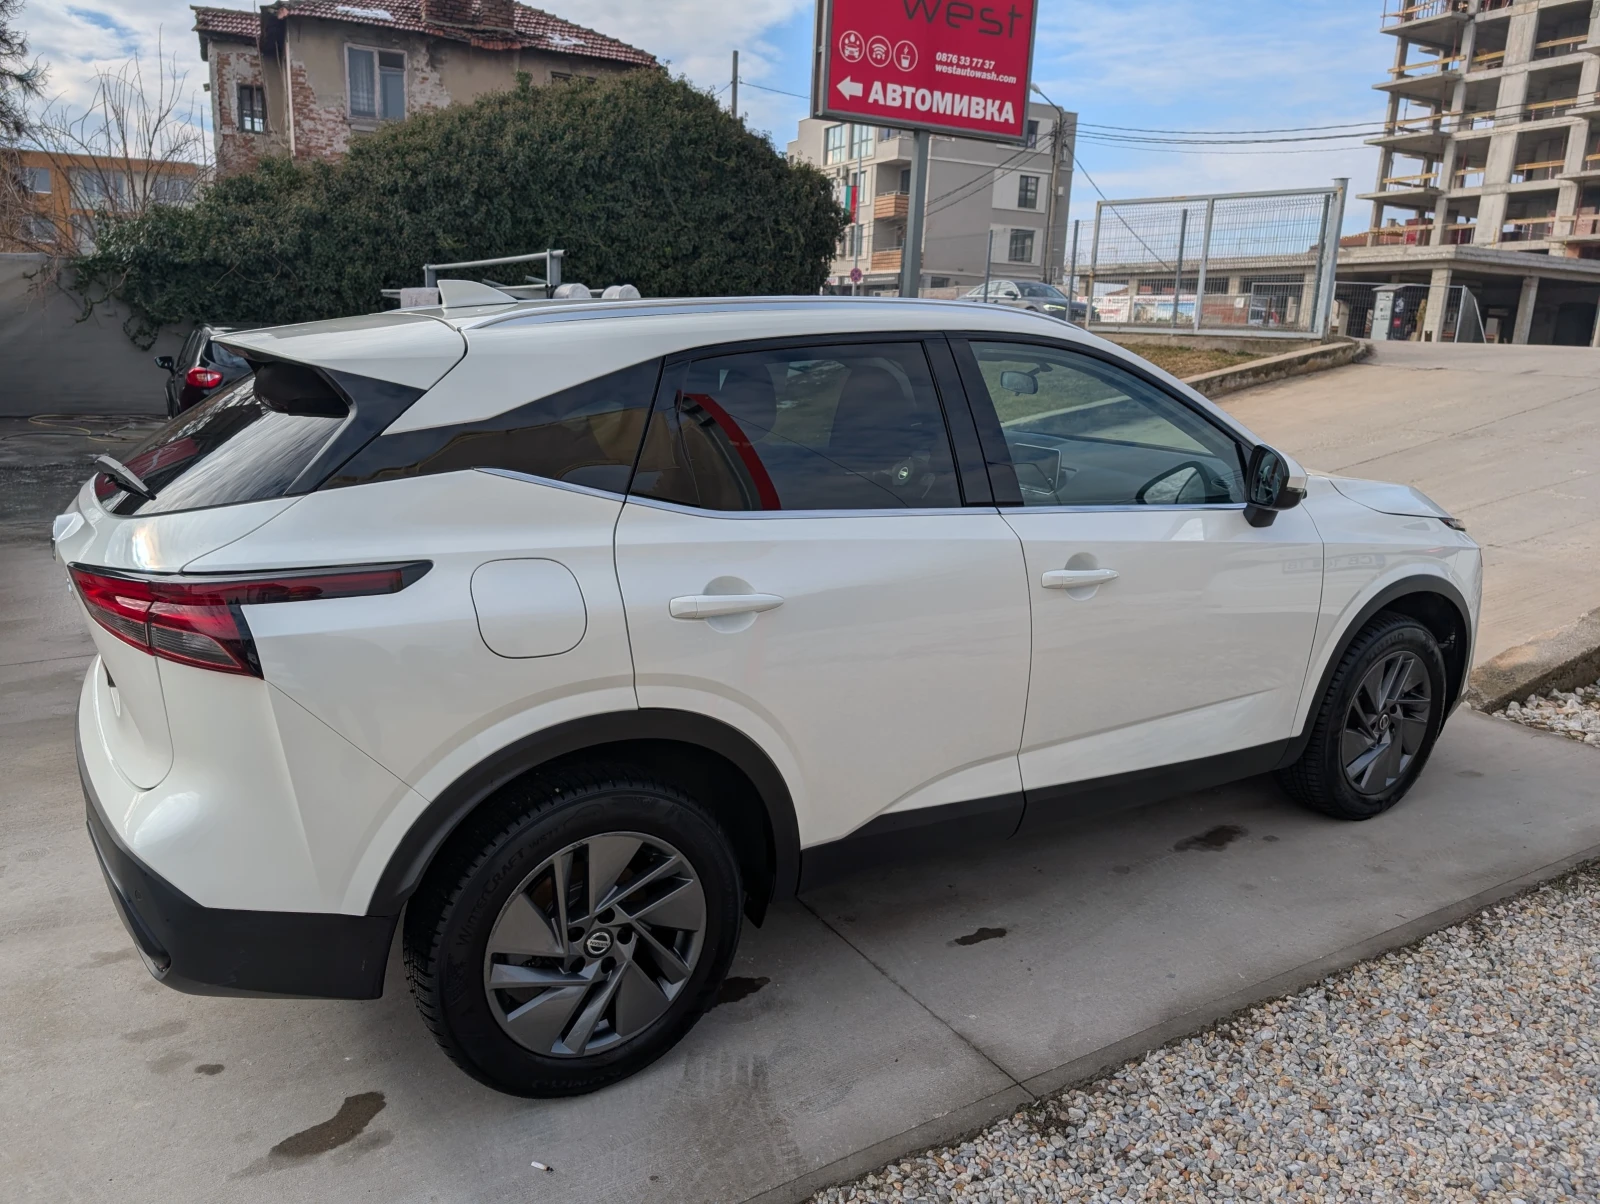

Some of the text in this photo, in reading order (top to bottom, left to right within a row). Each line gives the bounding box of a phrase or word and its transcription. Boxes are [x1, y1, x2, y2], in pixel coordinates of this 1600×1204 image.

[935, 52, 996, 70] 0876 33 77 37
[935, 64, 1017, 84] westautowash.com
[867, 81, 1016, 124] АВТОМИВКА
